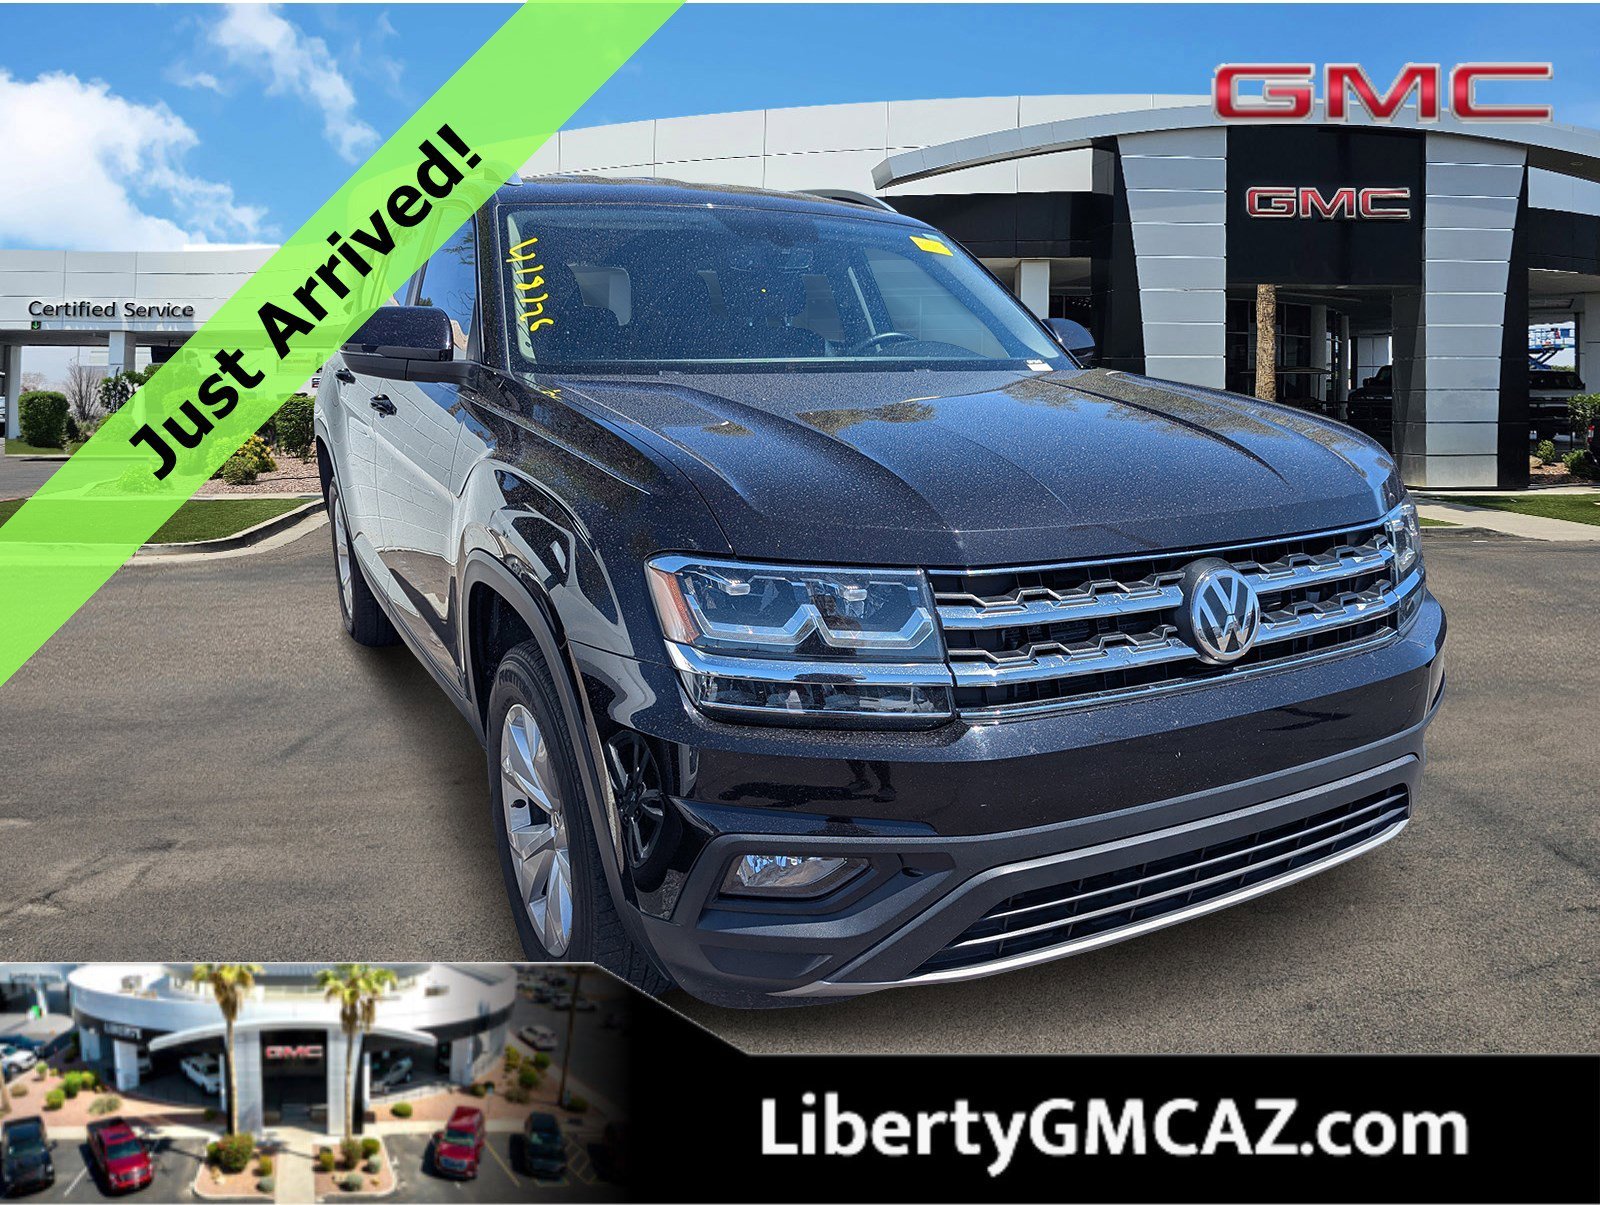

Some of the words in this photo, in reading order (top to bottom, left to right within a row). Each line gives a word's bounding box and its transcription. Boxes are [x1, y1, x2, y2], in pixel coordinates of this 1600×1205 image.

[1246, 186, 1411, 219] GMC
[28, 300, 116, 317] Certified
[123, 302, 194, 317] Service
